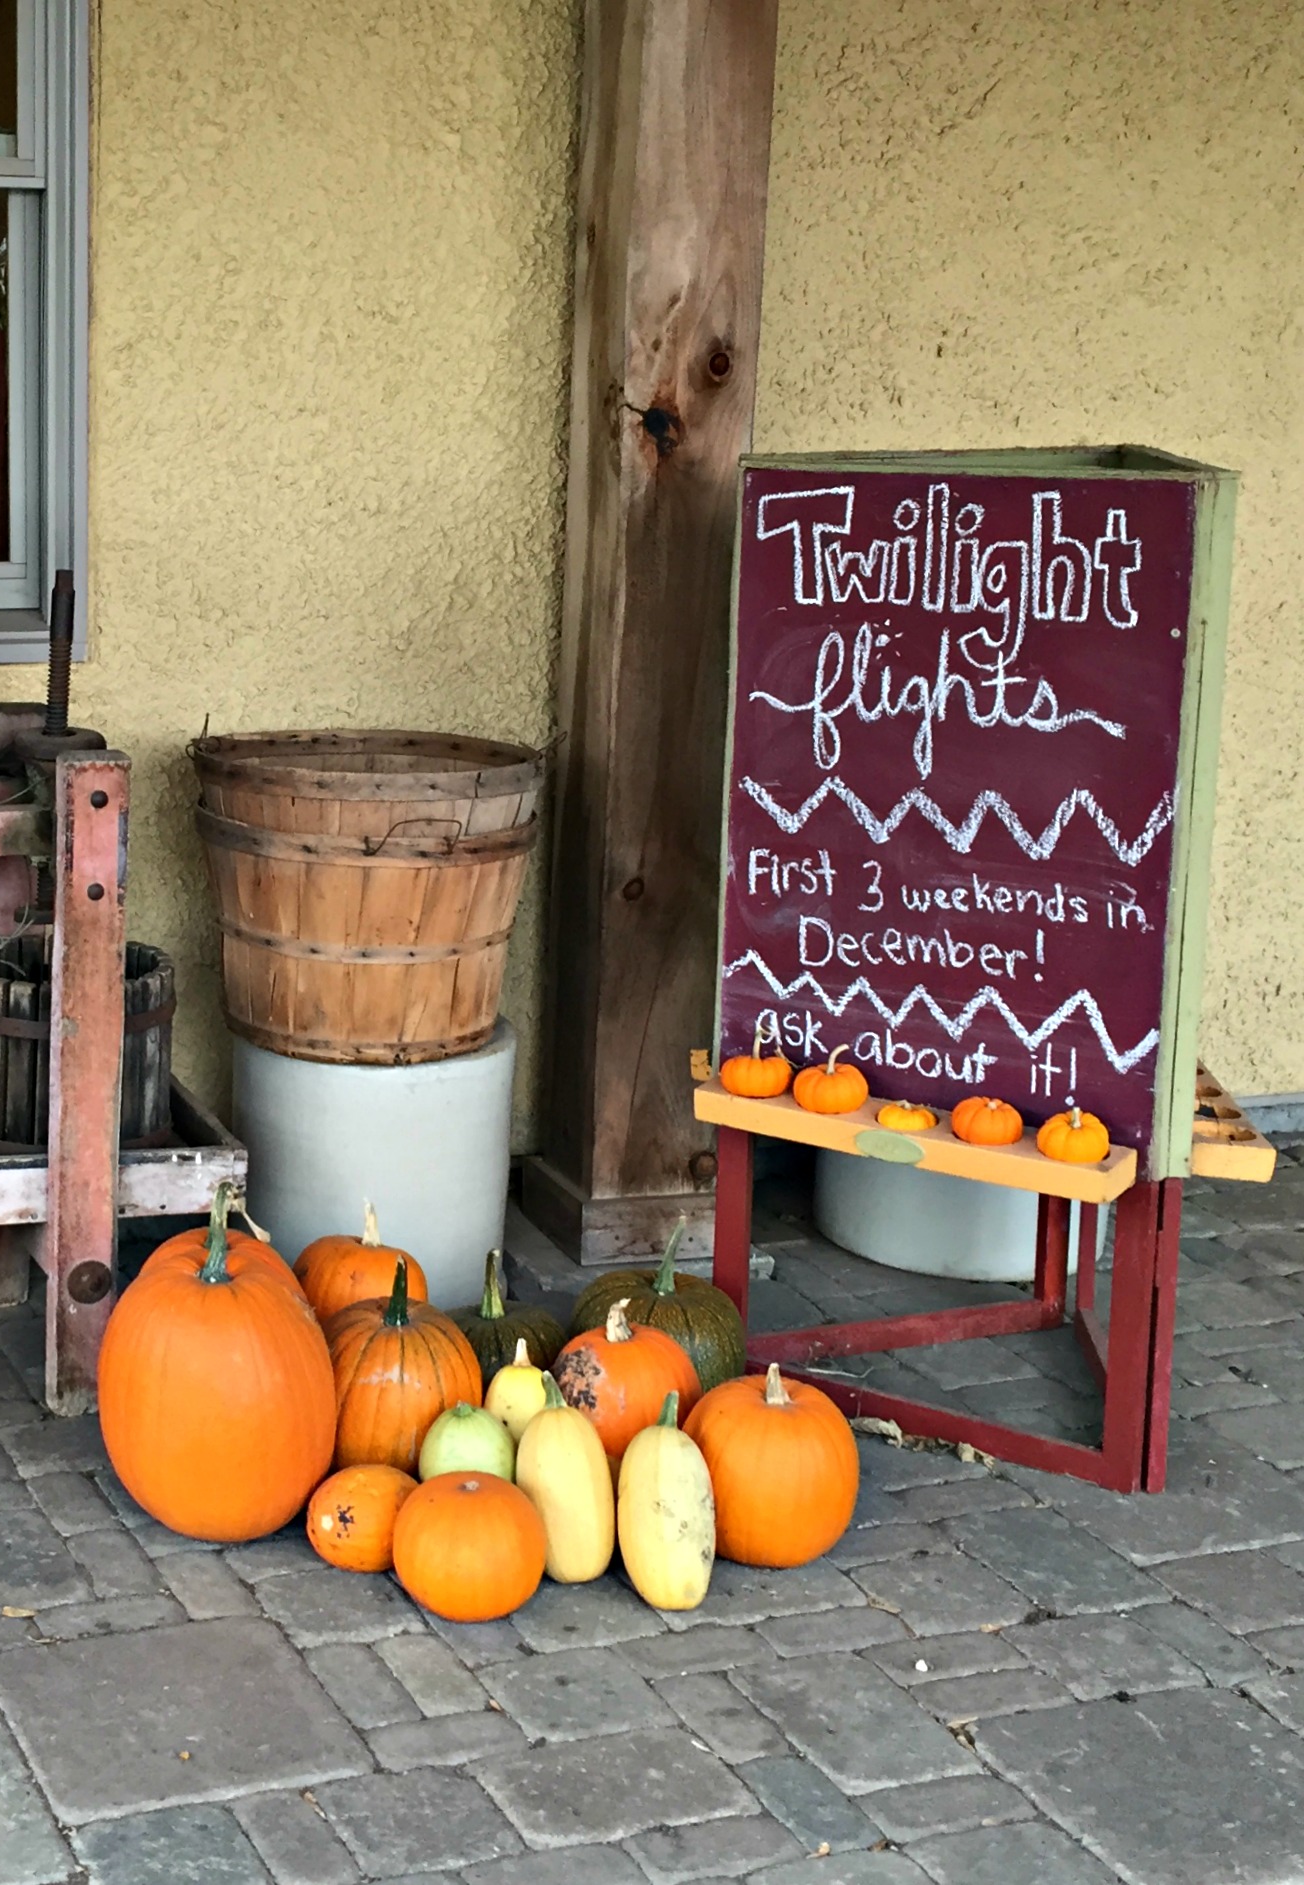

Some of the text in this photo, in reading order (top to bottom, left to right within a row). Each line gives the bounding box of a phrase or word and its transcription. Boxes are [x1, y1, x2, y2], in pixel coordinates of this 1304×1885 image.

[757, 482, 1142, 671] Twilight
[749, 618, 1127, 780] flights
[747, 847, 1151, 931] First 3 weekends in
[798, 914, 1046, 983] December!
[754, 1008, 1078, 1107] ask about it!
